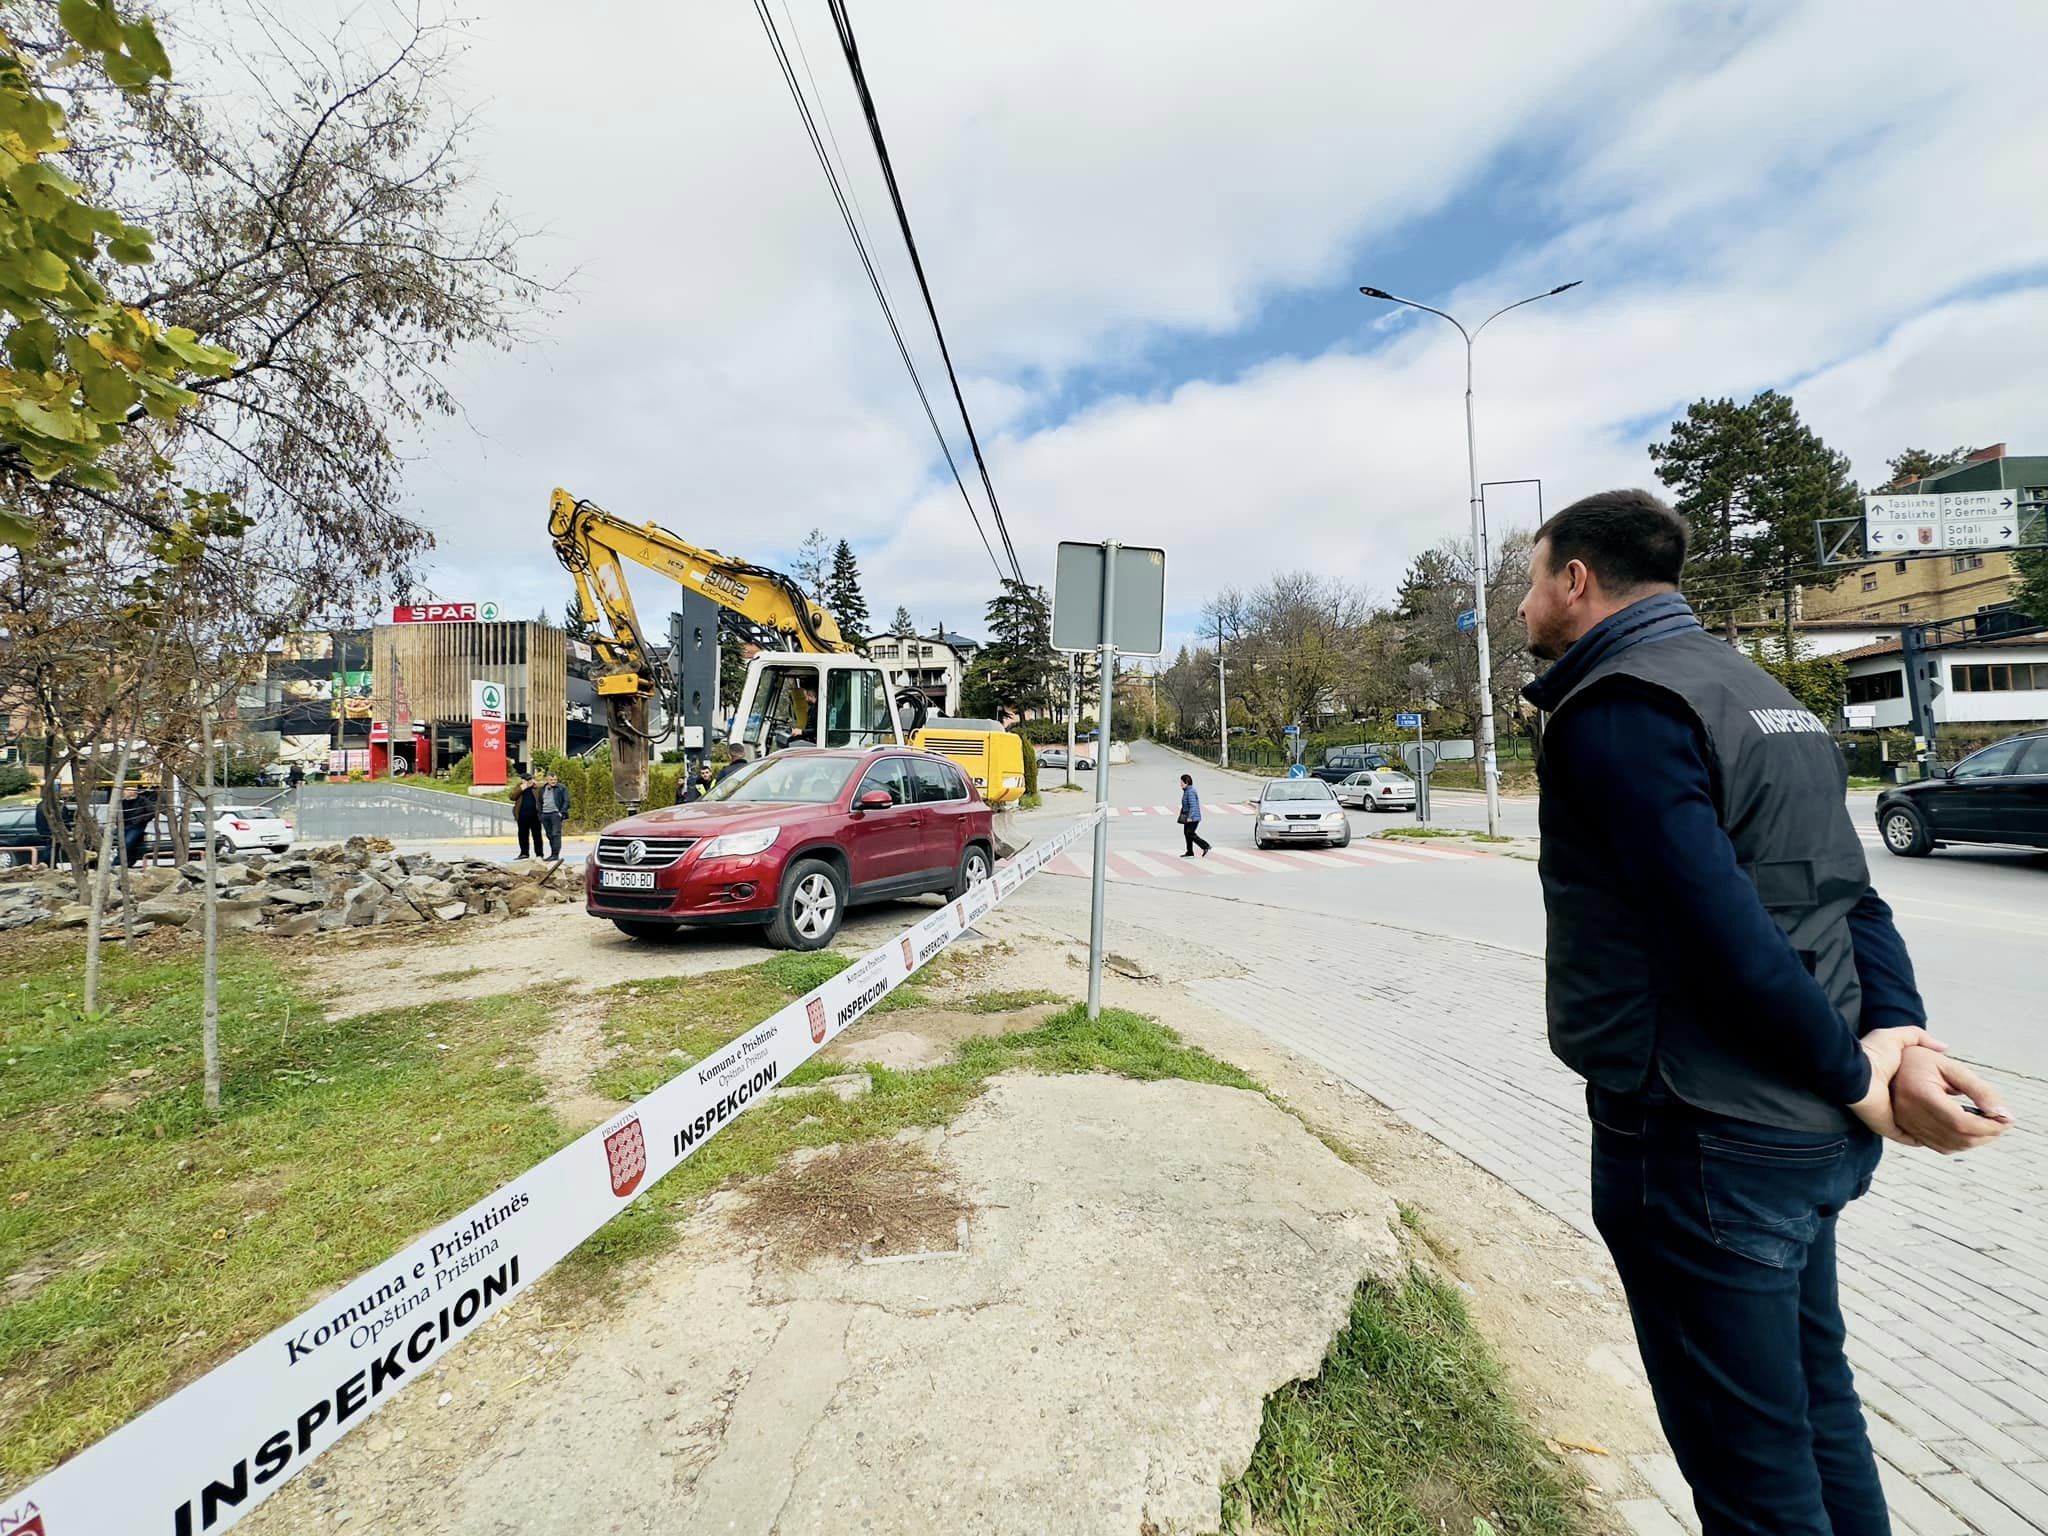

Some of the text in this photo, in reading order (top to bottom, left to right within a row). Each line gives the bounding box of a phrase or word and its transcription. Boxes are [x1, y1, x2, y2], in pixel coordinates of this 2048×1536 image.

[411, 605, 476, 620] SPAR
[837, 976, 888, 1027] INSPEKCIONI
[698, 1054, 736, 1086] Komuna
[736, 1049, 742, 1060] e
[601, 1110, 639, 1138] PRISHTINA
[673, 1060, 778, 1158] INSPEKCIONI
[286, 1188, 531, 1367] Komuna e Prishtinës
[349, 1235, 501, 1353] Opština Priština
[173, 1254, 522, 1536] INSPEKCIONI
